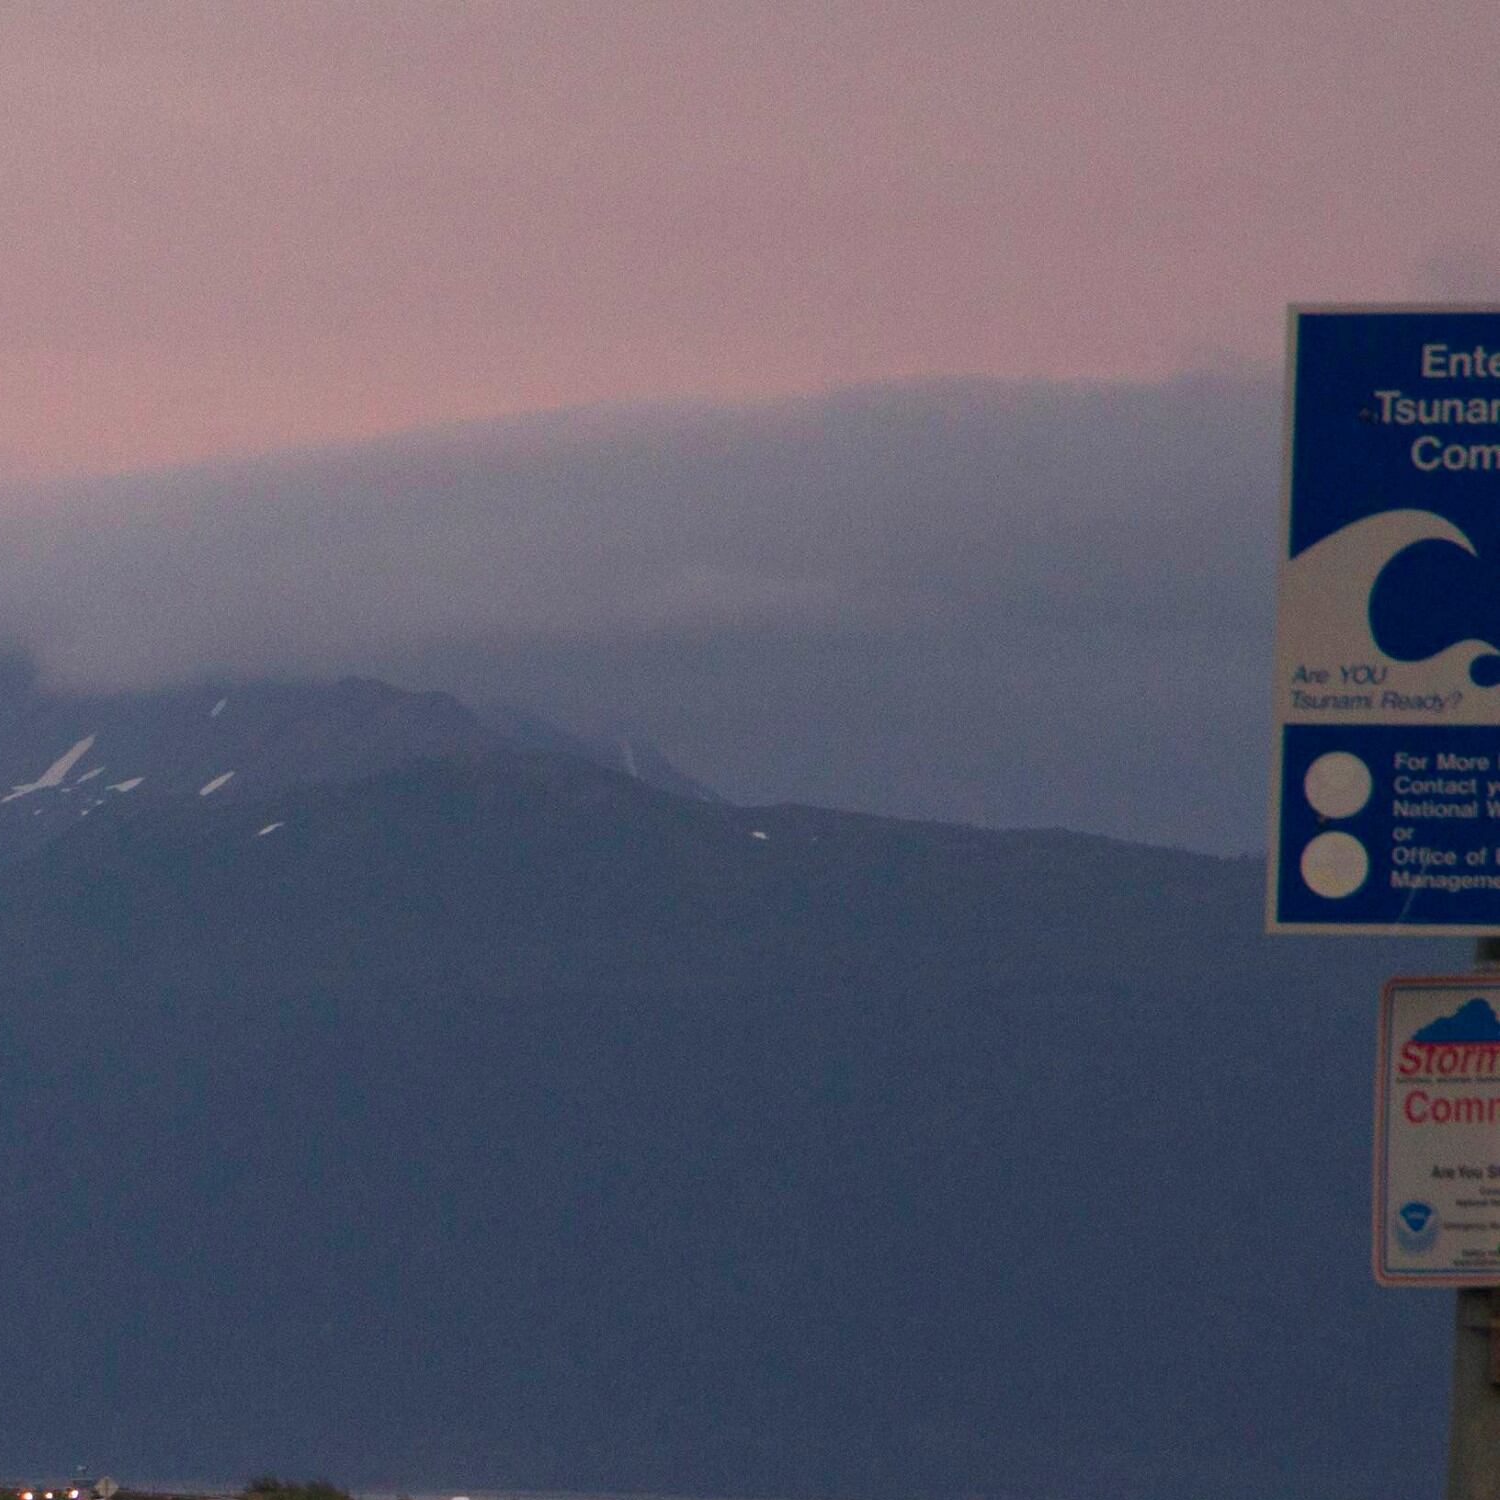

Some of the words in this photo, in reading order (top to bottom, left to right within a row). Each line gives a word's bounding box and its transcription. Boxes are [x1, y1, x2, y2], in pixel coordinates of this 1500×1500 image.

[1292, 665, 1329, 684] Are
[1339, 664, 1388, 685] YOU
[1291, 689, 1372, 710] Tsunami
[1394, 752, 1427, 770] For
[1437, 753, 1490, 770] More
[1394, 776, 1477, 794] Contact
[1393, 800, 1478, 817] National
[1392, 827, 1414, 841] or
[1392, 847, 1456, 865] Office
[1465, 846, 1488, 865] of
